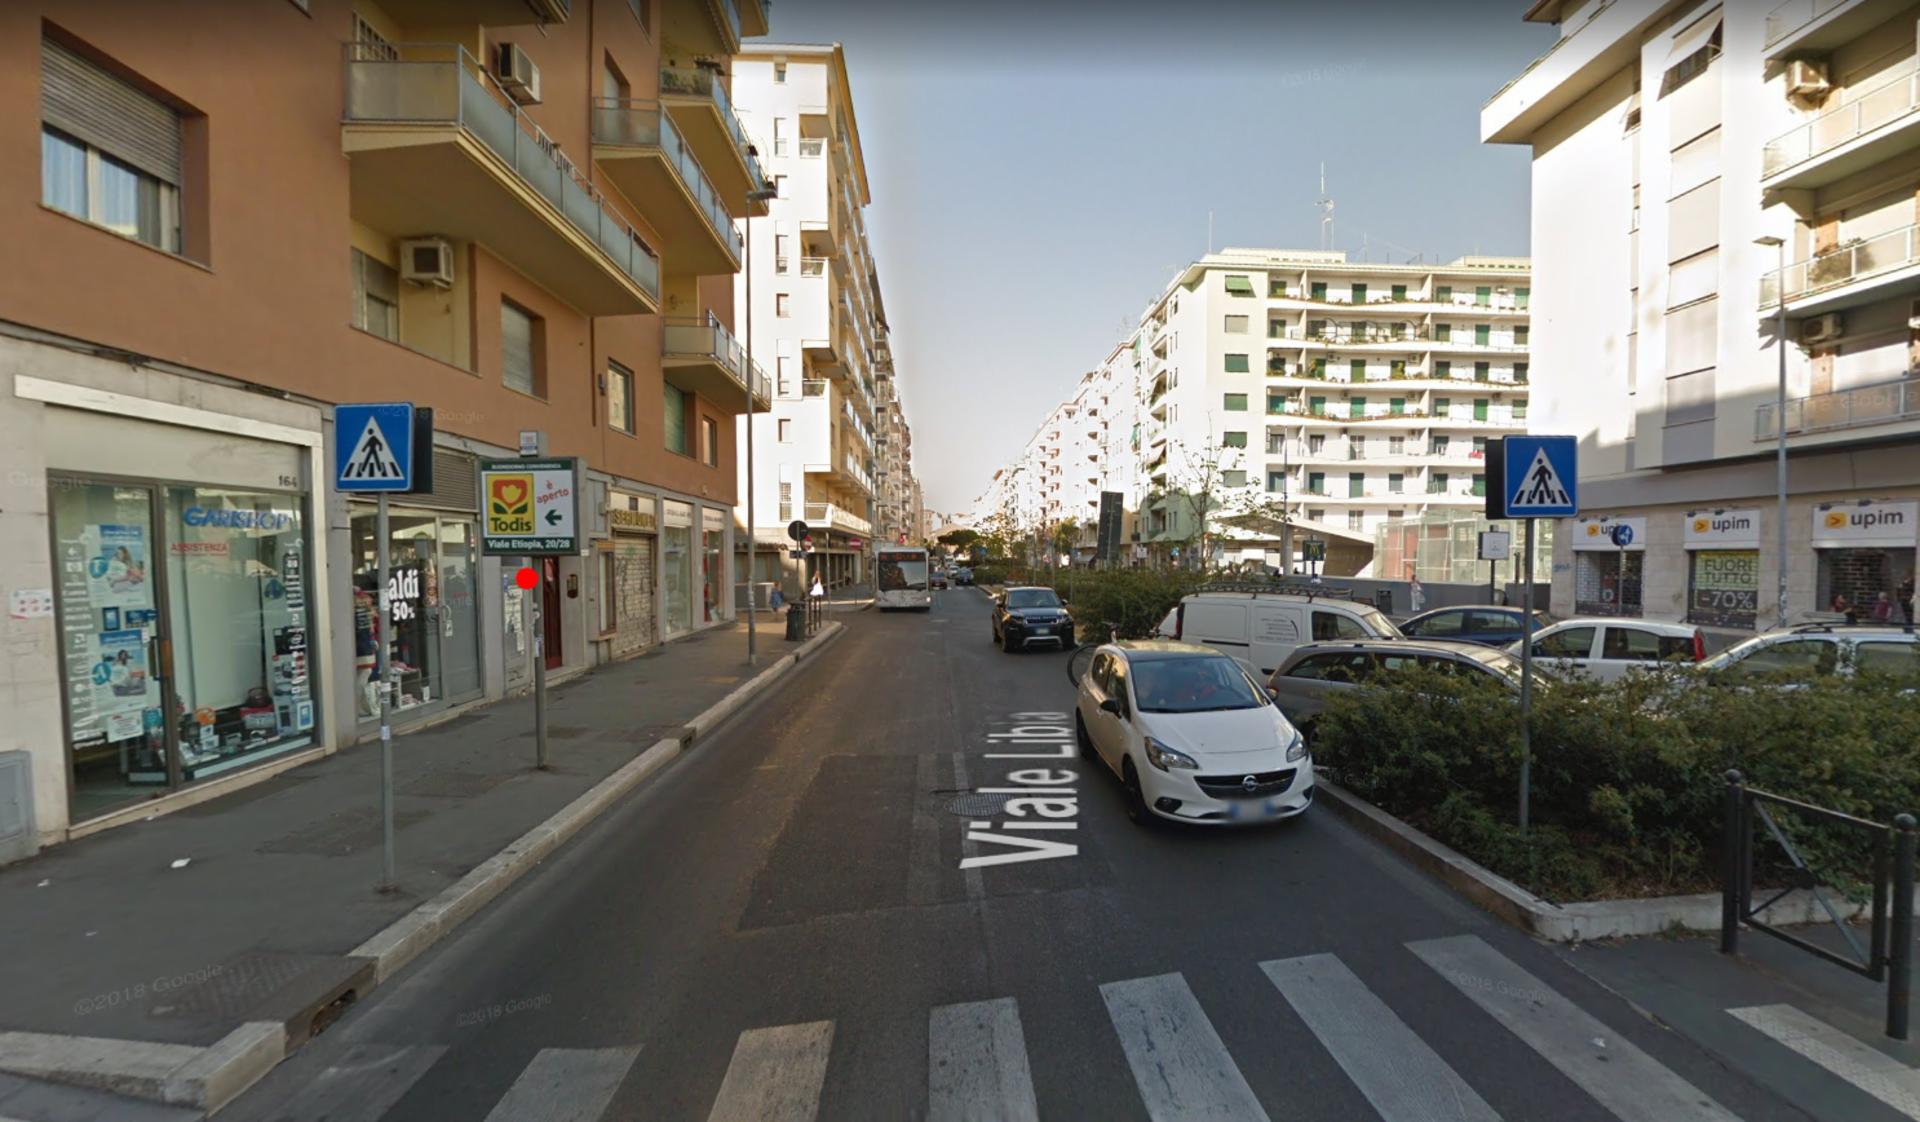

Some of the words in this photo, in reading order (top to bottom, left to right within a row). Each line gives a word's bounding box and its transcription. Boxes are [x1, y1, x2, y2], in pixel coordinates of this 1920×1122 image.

[536, 488, 569, 505] aperto
[183, 505, 289, 529] GARISHOP
[490, 517, 532, 532] Todis
[1712, 516, 1750, 532] upim
[1851, 510, 1903, 529] upim
[171, 542, 228, 553] ASSISTENZA
[488, 540, 510, 549] Viale
[545, 539, 570, 549] 20/28
[1705, 558, 1753, 572] FUORI
[388, 569, 419, 600] aldi
[1705, 572, 1752, 585] TUTTO
[393, 601, 415, 621] 50%
